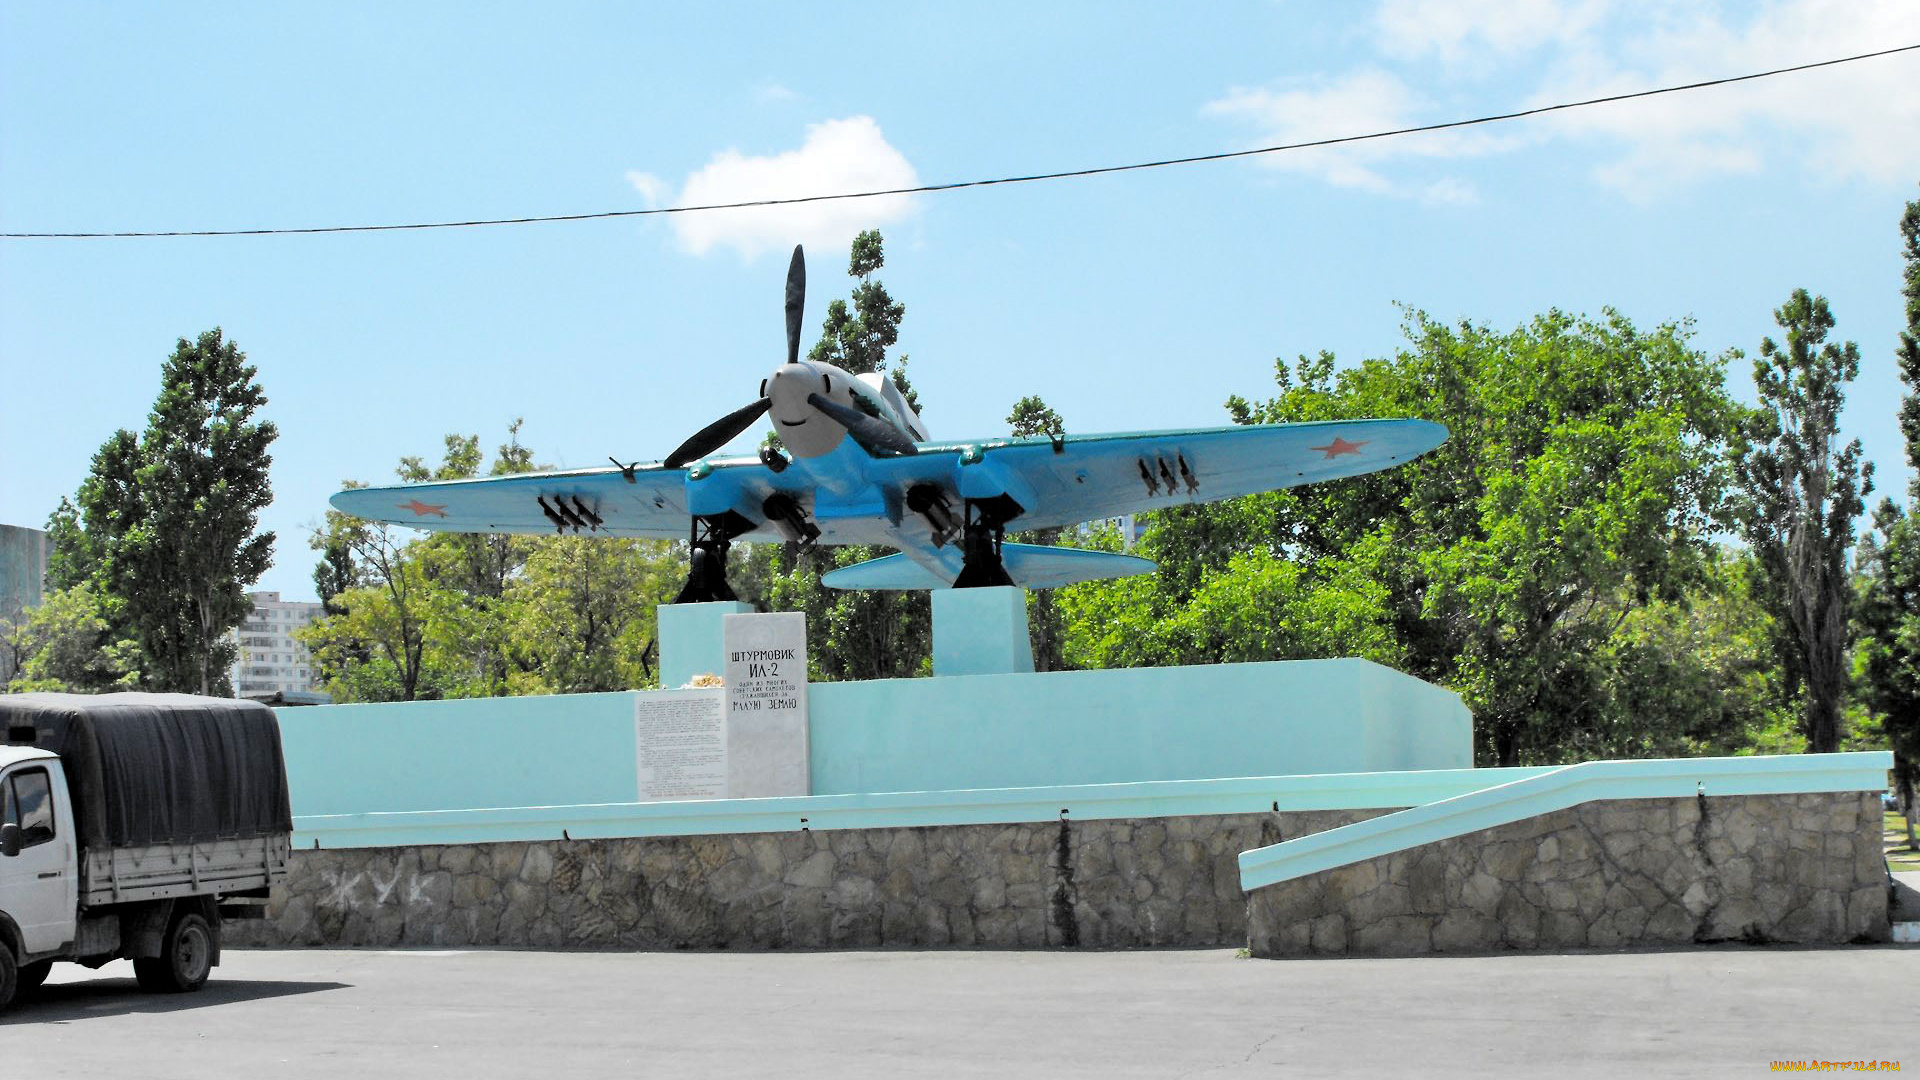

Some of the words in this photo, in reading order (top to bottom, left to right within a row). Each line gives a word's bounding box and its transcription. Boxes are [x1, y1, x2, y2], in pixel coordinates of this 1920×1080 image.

[731, 649, 795, 662] ШТУРМОВИК
[749, 662, 779, 678] ИЛ-2
[733, 700, 761, 711] МАЛУЮ
[768, 698, 797, 710] ЗЕМЛЮ
